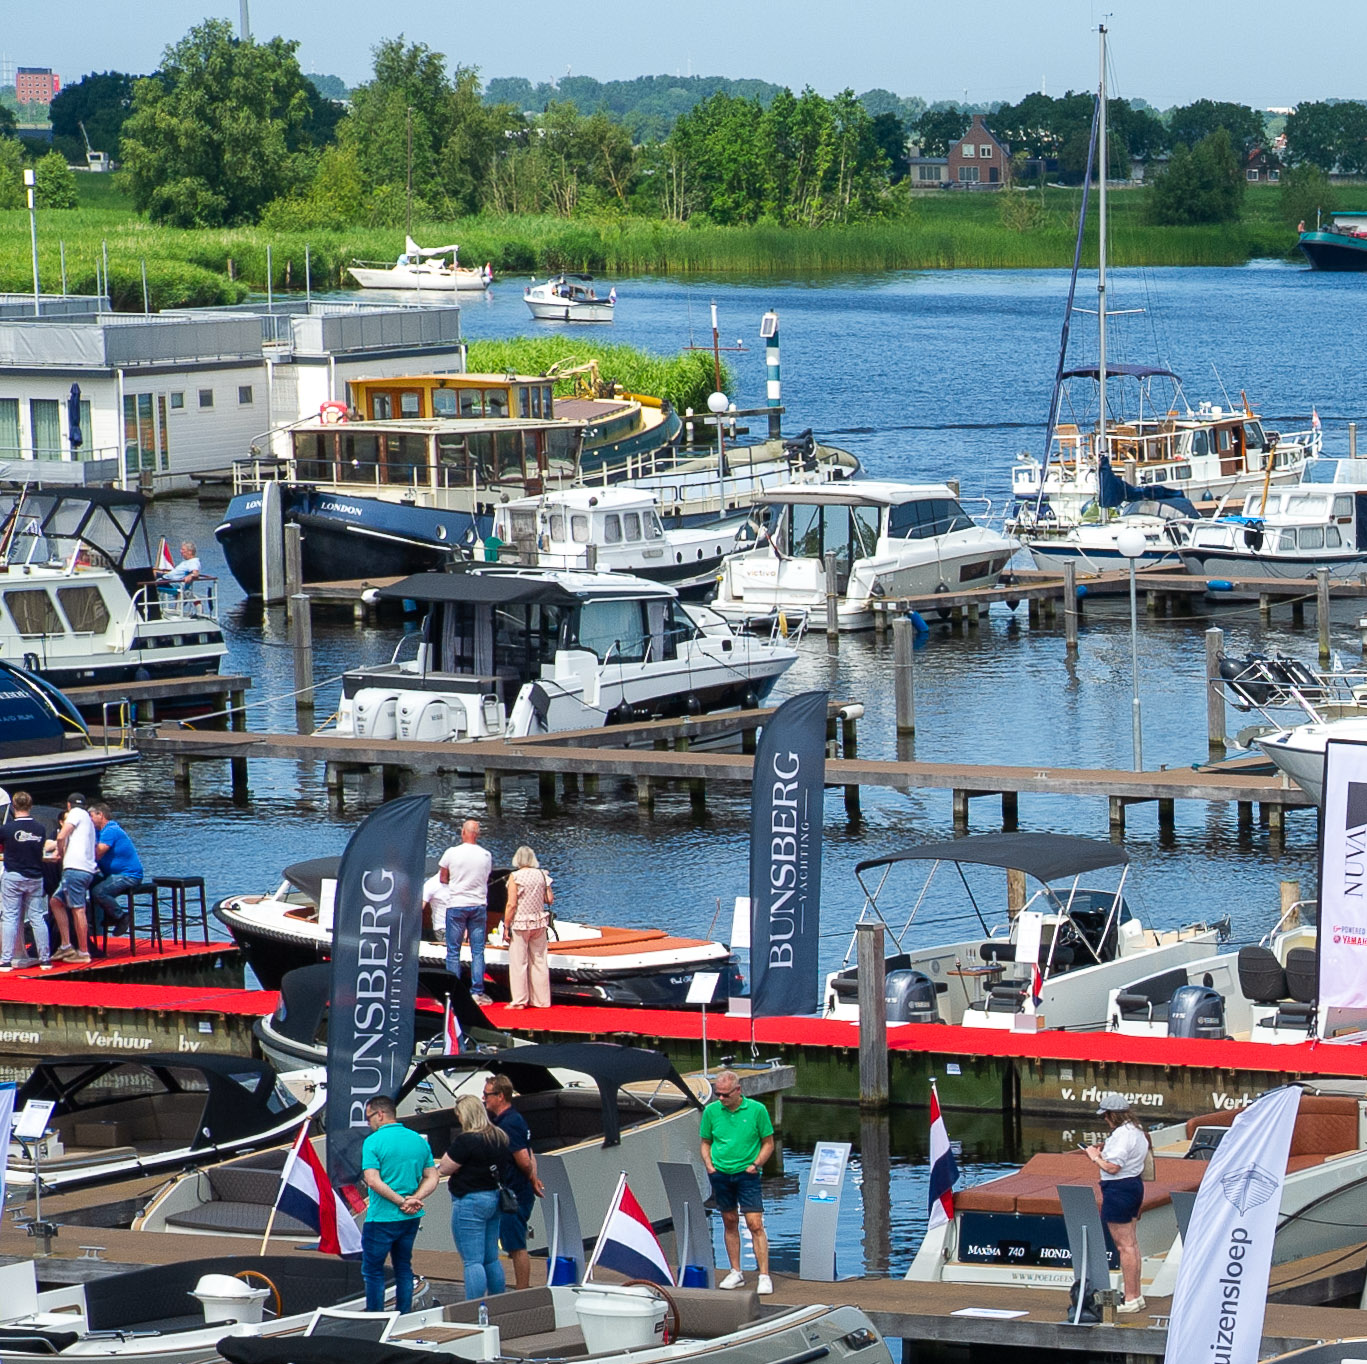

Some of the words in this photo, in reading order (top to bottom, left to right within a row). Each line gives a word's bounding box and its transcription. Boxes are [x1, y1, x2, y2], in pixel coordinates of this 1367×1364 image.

[321, 502, 363, 516] LONDON
[768, 750, 800, 969] BUNSBERG
[799, 822, 810, 902] YACHTING
[1344, 828, 1367, 899] NUVA
[1341, 925, 1366, 936] POWERED
[349, 868, 395, 1129] BUNSBERG
[388, 952, 404, 1048] YACHTING
[86, 1031, 152, 1050] Verhuur
[1081, 1086, 1163, 1106] Heren
[1008, 1246, 1025, 1258] 740
[1040, 1248, 1073, 1259] HOND
